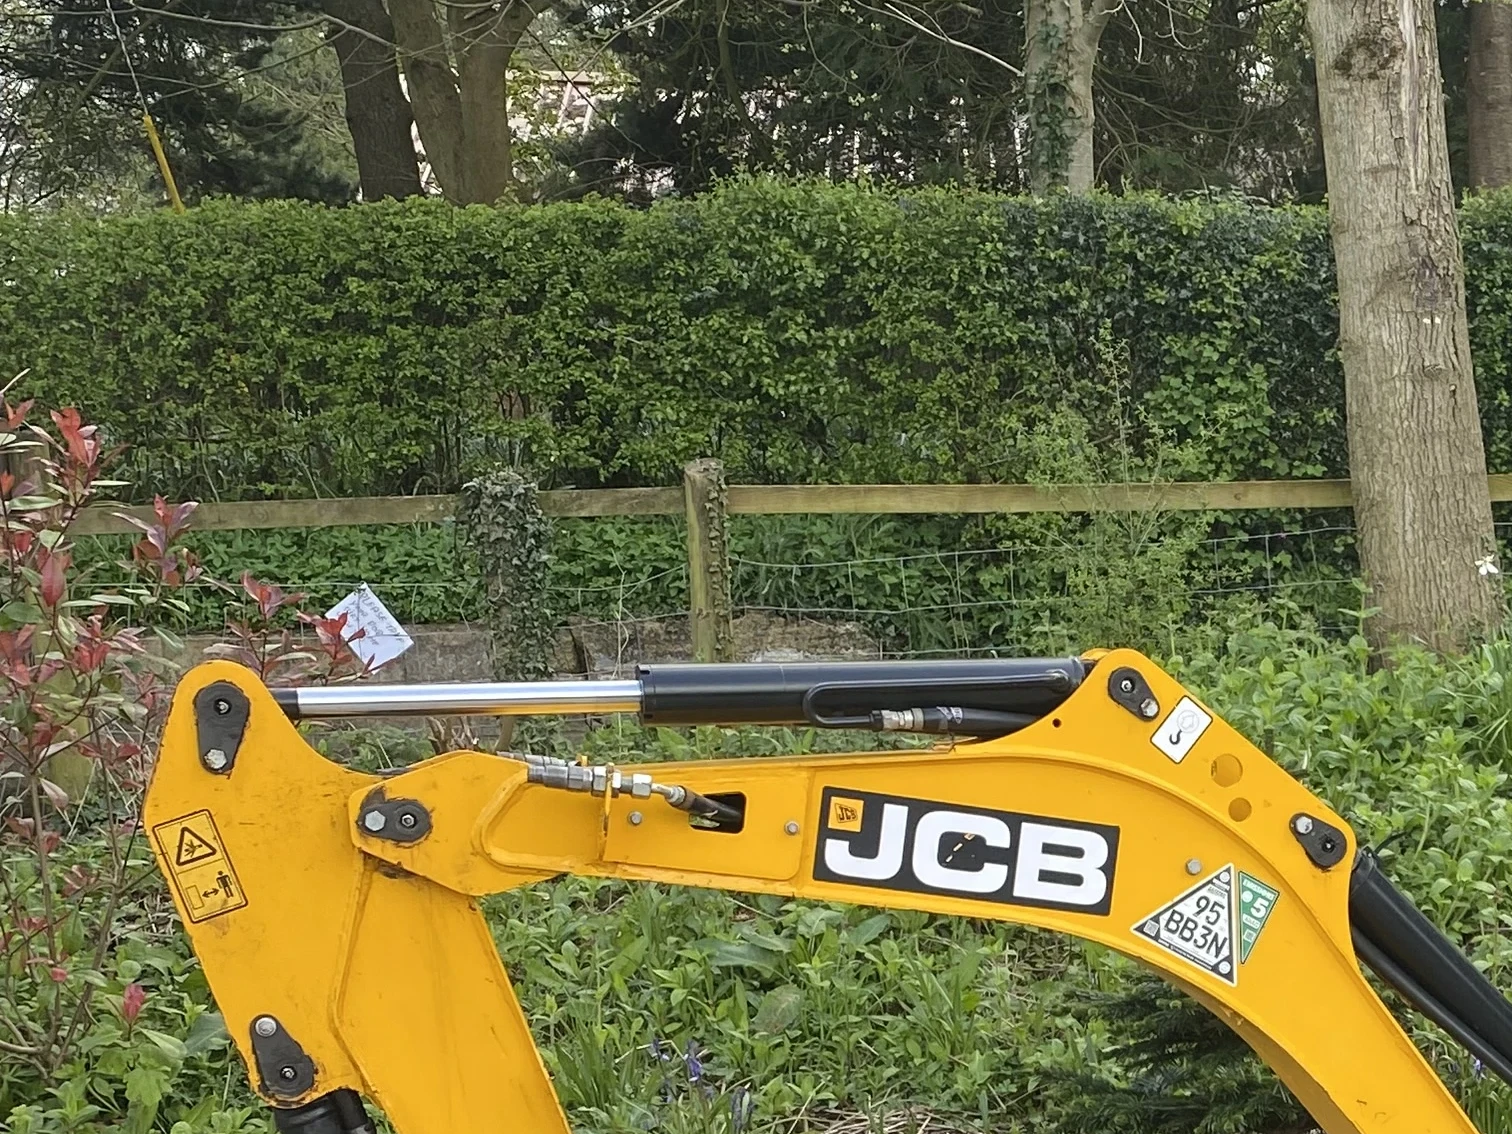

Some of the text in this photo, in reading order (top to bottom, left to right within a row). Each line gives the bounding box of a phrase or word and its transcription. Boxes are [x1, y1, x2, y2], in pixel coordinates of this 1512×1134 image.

[824, 802, 1108, 906] JCB
[1192, 895, 1225, 926] 95
[1250, 897, 1270, 919] 5
[1164, 909, 1228, 959] BB3N
